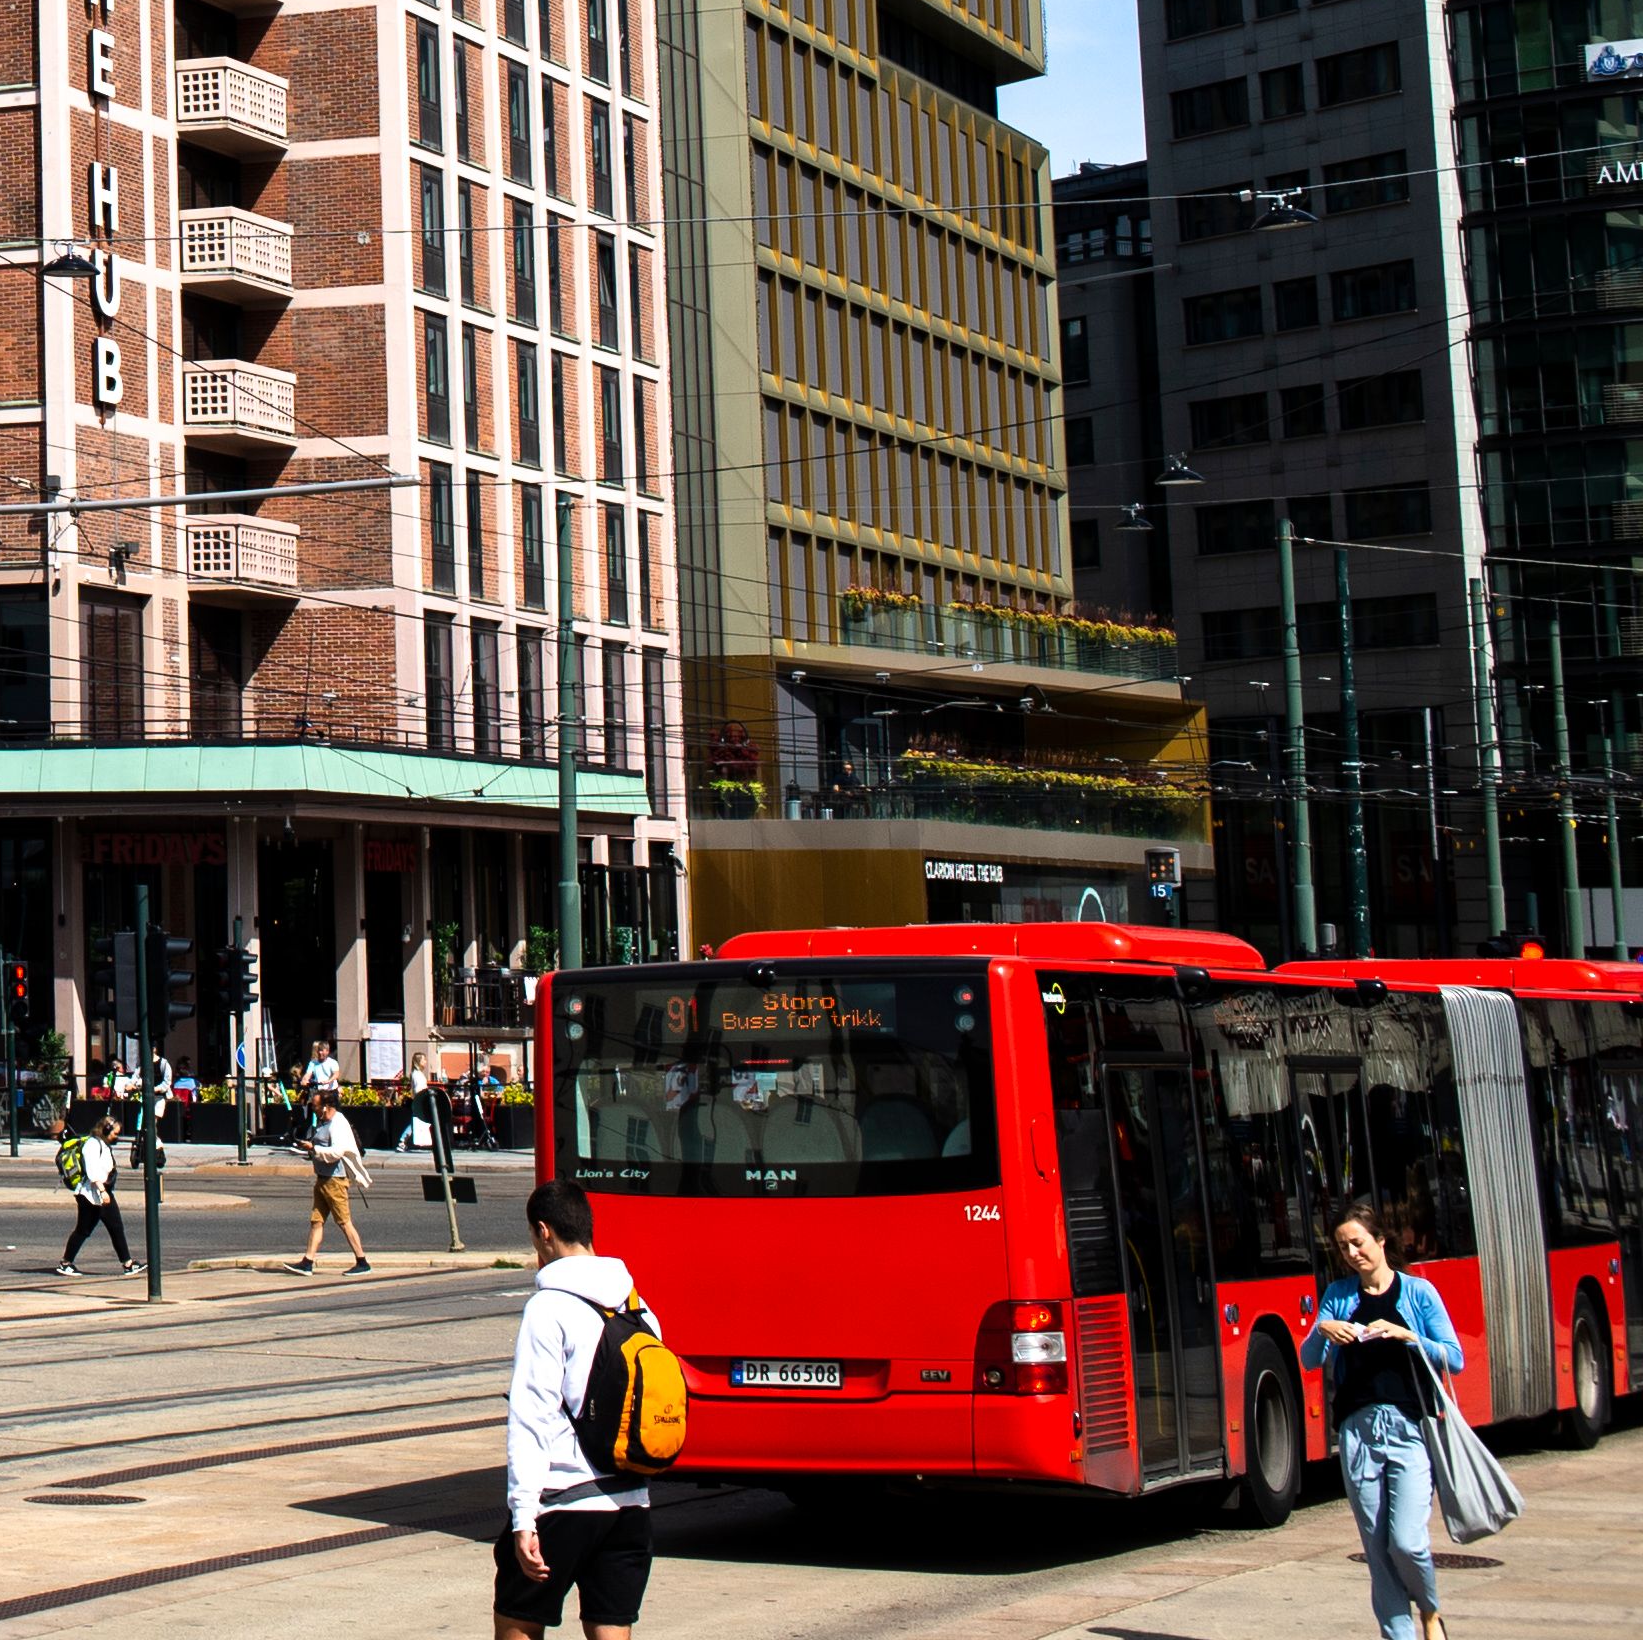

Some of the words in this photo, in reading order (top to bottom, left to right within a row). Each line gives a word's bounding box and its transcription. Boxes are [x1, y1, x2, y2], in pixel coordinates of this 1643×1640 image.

[92, 161, 124, 406] HUB
[925, 861, 954, 879] CLARION
[956, 863, 976, 881] HOTEL
[1152, 884, 1166, 898] 15
[667, 996, 698, 1033] 91
[763, 993, 836, 1011] Storo
[723, 1013, 778, 1030] Buss
[786, 1011, 822, 1029] for
[830, 1010, 882, 1028] trikk
[575, 1168, 614, 1178] Lion's
[619, 1168, 650, 1180] City
[745, 1169, 797, 1181] MAN
[964, 1205, 1001, 1221] 1244
[746, 1363, 770, 1382] DR
[779, 1363, 837, 1384] 66508
[921, 1370, 948, 1381] EEV
